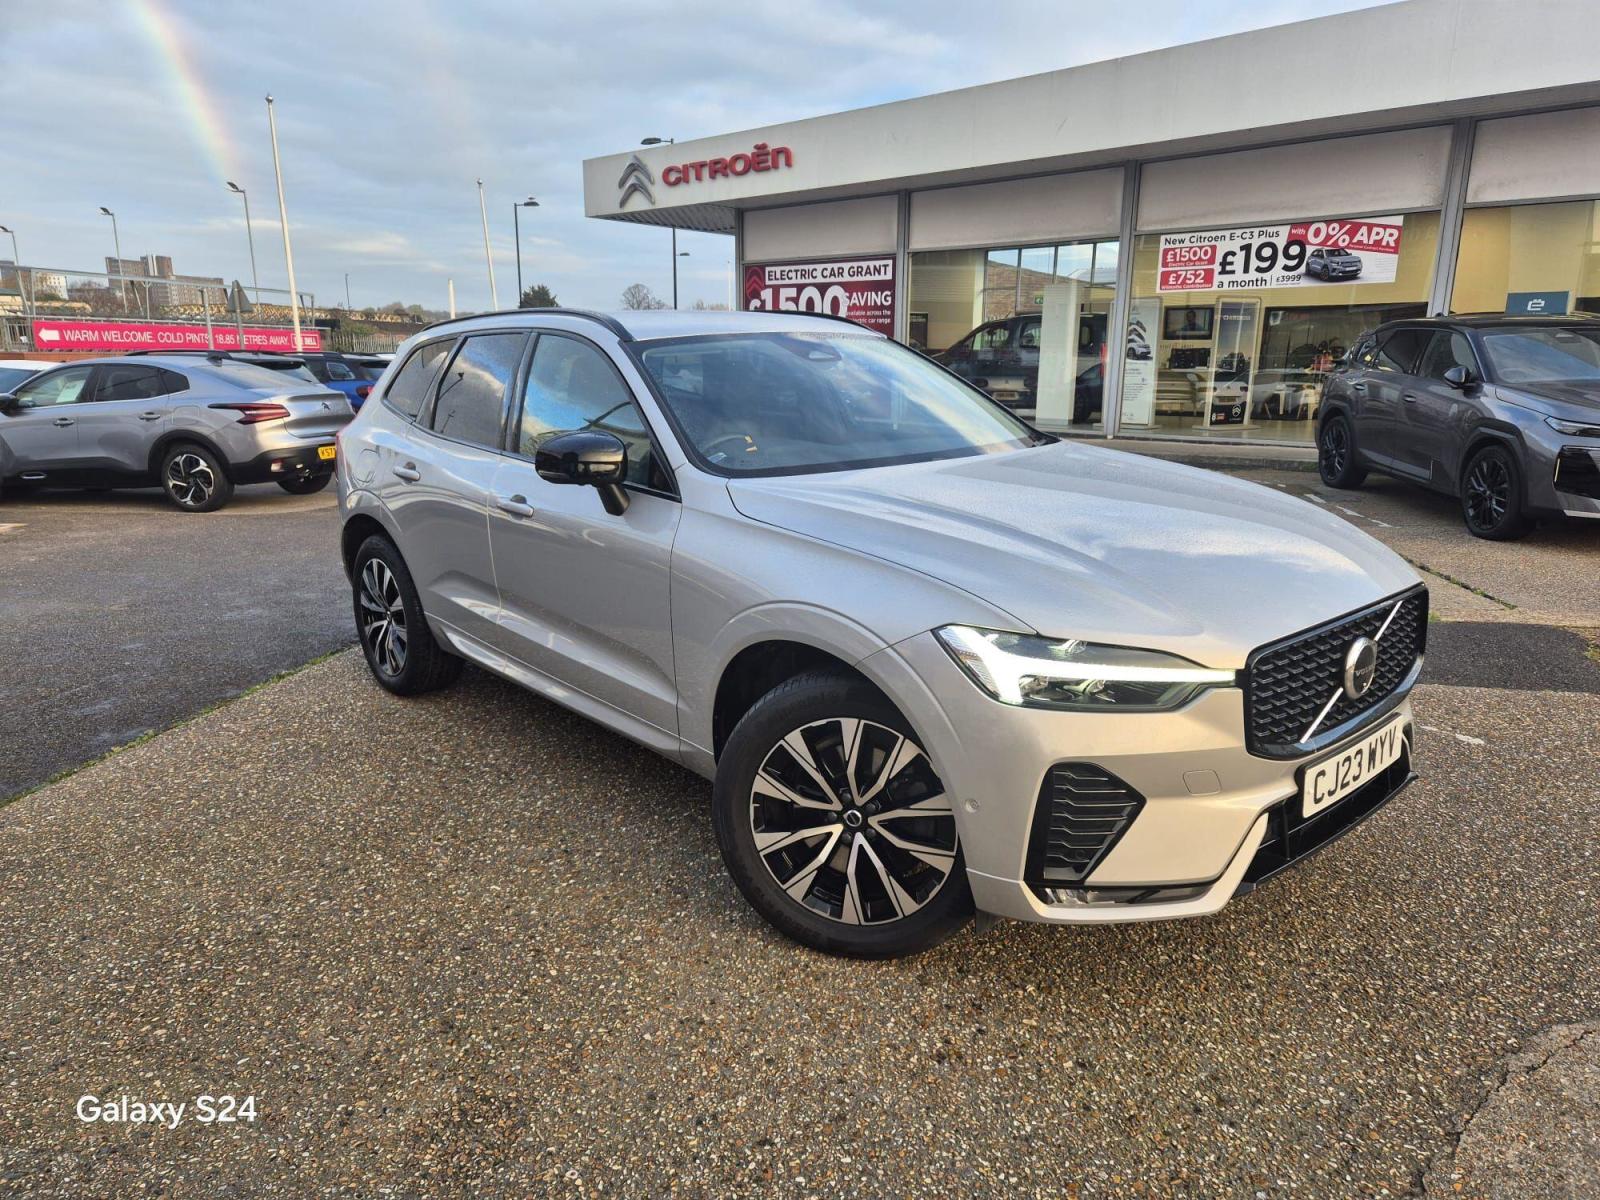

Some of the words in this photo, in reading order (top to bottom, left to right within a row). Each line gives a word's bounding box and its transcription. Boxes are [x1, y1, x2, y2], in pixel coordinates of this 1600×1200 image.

[1164, 237, 1186, 246] New
[1189, 234, 1226, 244] Citroen
[1229, 231, 1254, 240] E-C3
[1258, 228, 1280, 238] Plus
[1307, 222, 1352, 246] 0%
[1352, 225, 1399, 247] APR
[1166, 246, 1212, 262] £1500
[1218, 240, 1307, 275] £199
[767, 268, 818, 281] ELECTRIC
[821, 267, 844, 279] CAR
[847, 264, 890, 278] GRANT
[1168, 270, 1205, 285] £752
[1276, 274, 1302, 282] £3999
[1228, 276, 1267, 288] month
[844, 291, 892, 306] SAVING
[63, 329, 99, 341] WARM
[101, 330, 156, 343] WELCOME.
[157, 331, 183, 343] COLD
[215, 334, 235, 344] 18.85
[1313, 749, 1364, 805] CJ23
[1367, 725, 1397, 774] WYV
